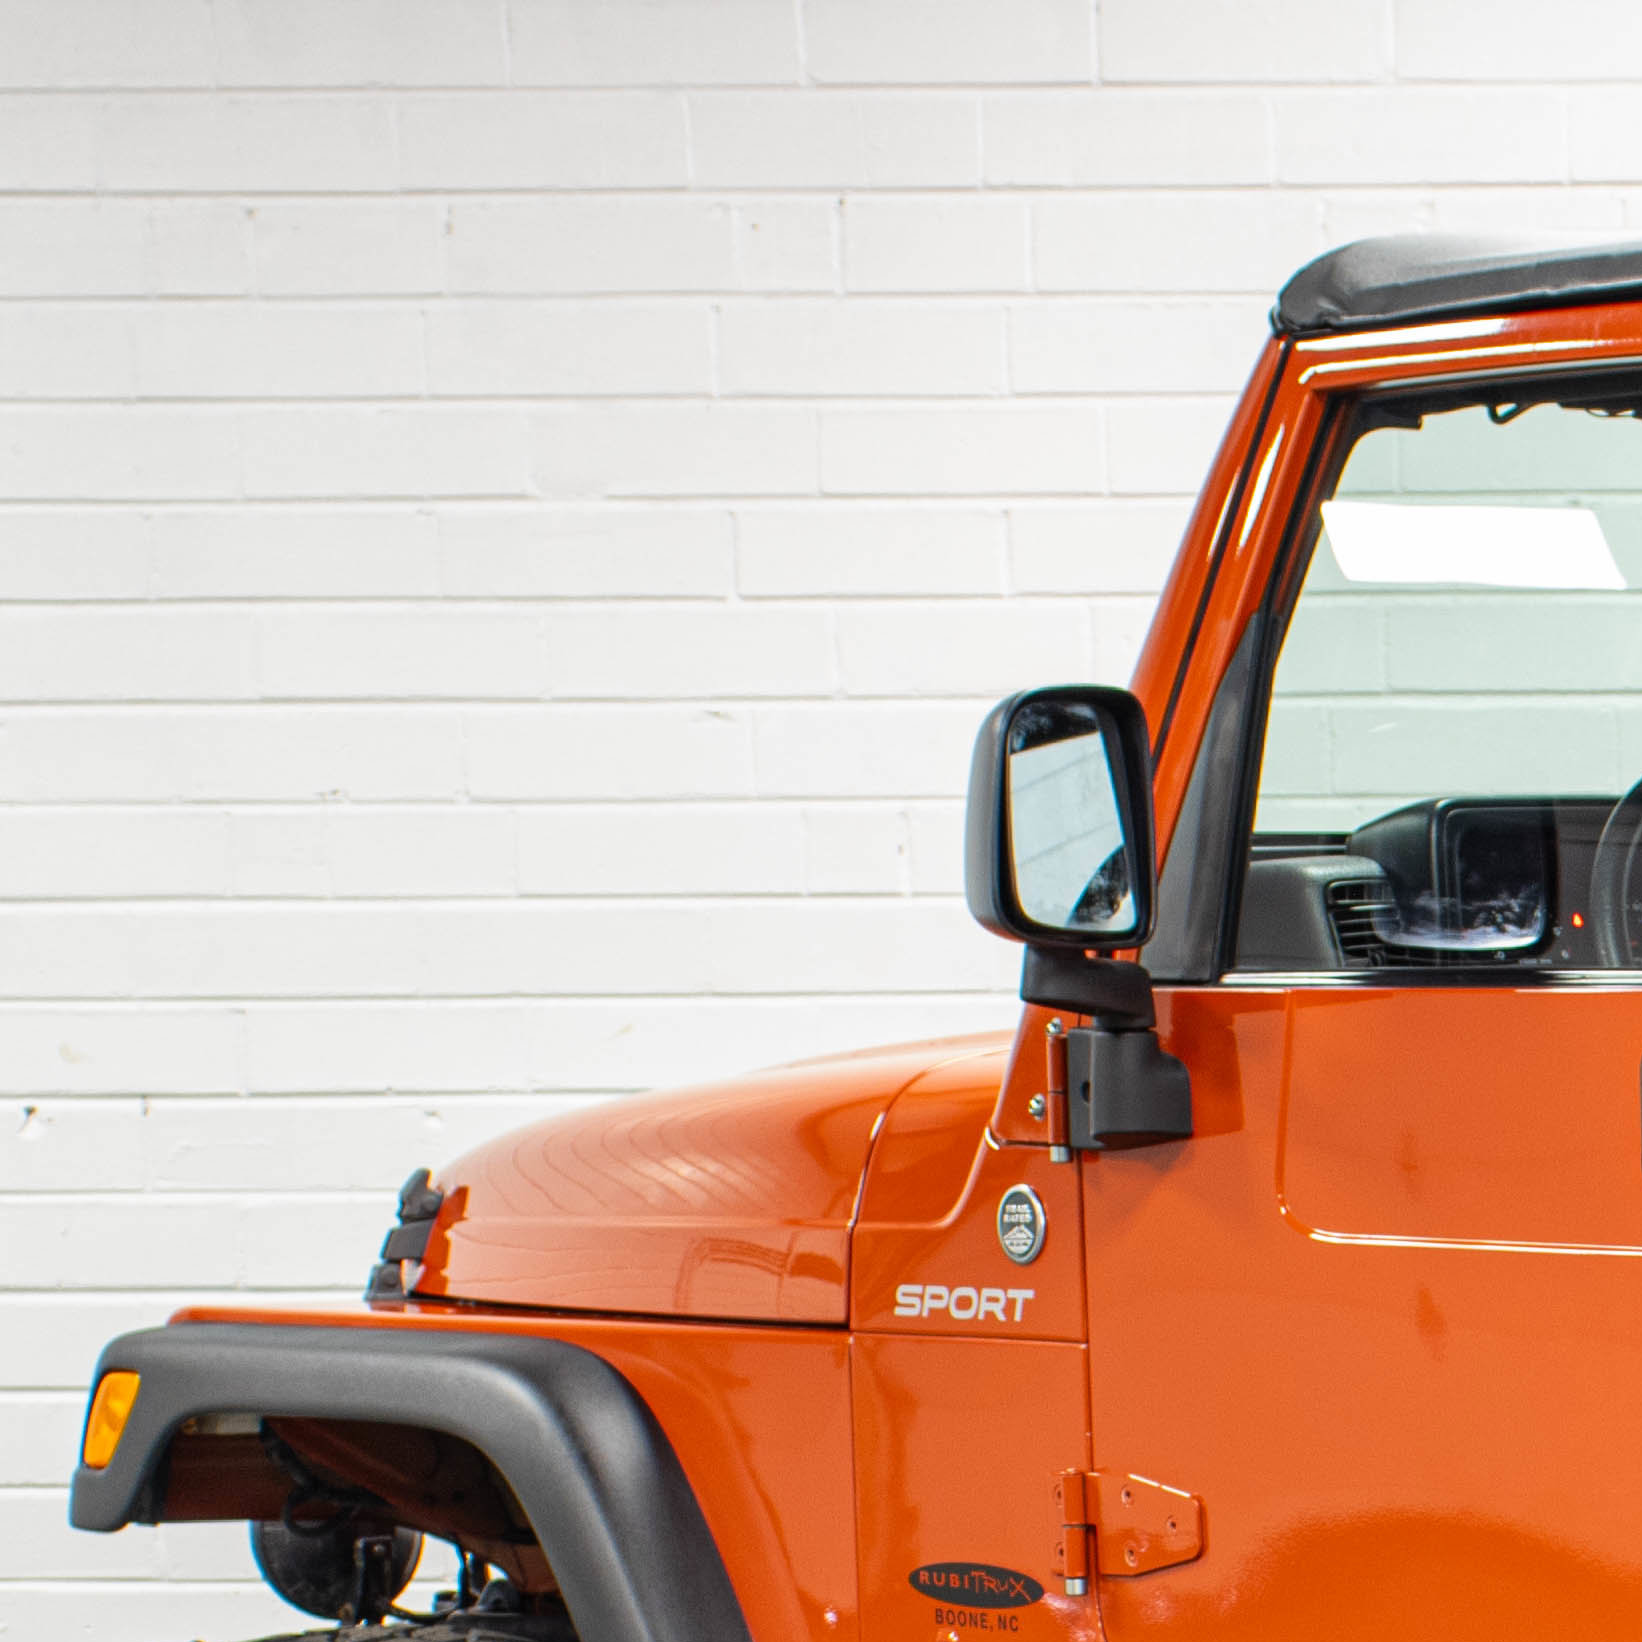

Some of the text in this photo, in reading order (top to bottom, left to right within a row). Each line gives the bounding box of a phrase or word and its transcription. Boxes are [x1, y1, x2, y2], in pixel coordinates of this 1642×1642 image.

[893, 1283, 1036, 1322] SPORT
[935, 1608, 1019, 1632] BOONE, NC
